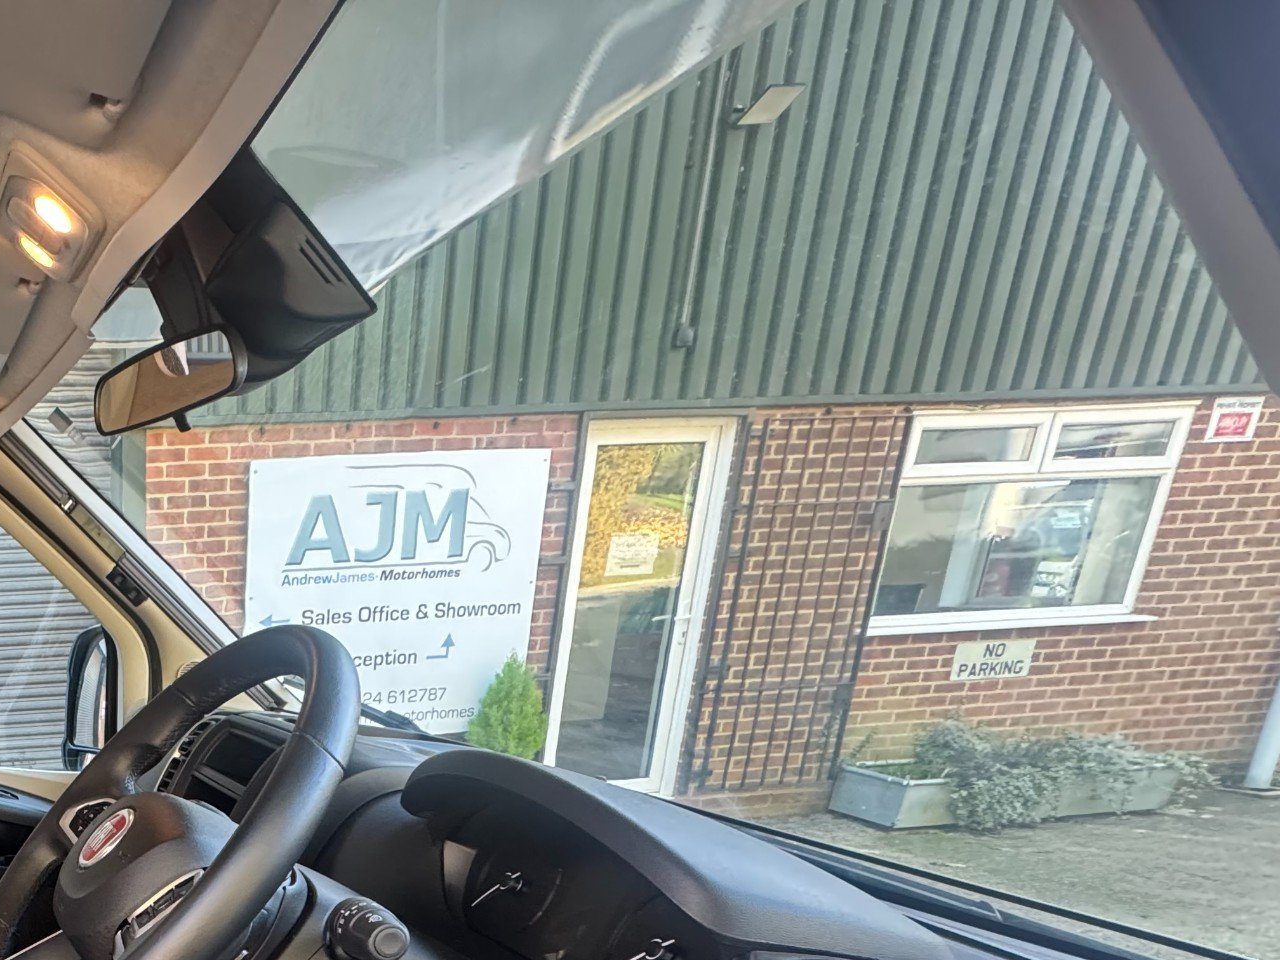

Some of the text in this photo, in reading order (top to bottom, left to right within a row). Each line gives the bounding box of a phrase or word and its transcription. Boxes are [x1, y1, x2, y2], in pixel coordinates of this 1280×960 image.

[285, 487, 470, 566] AJM
[301, 601, 522, 626] Sales Office & Showroom
[353, 649, 417, 670] ception
[983, 643, 1006, 658] NO
[957, 660, 1024, 677] PARKING
[362, 687, 447, 705] 24 612787
[403, 706, 475, 722] otorhomes
